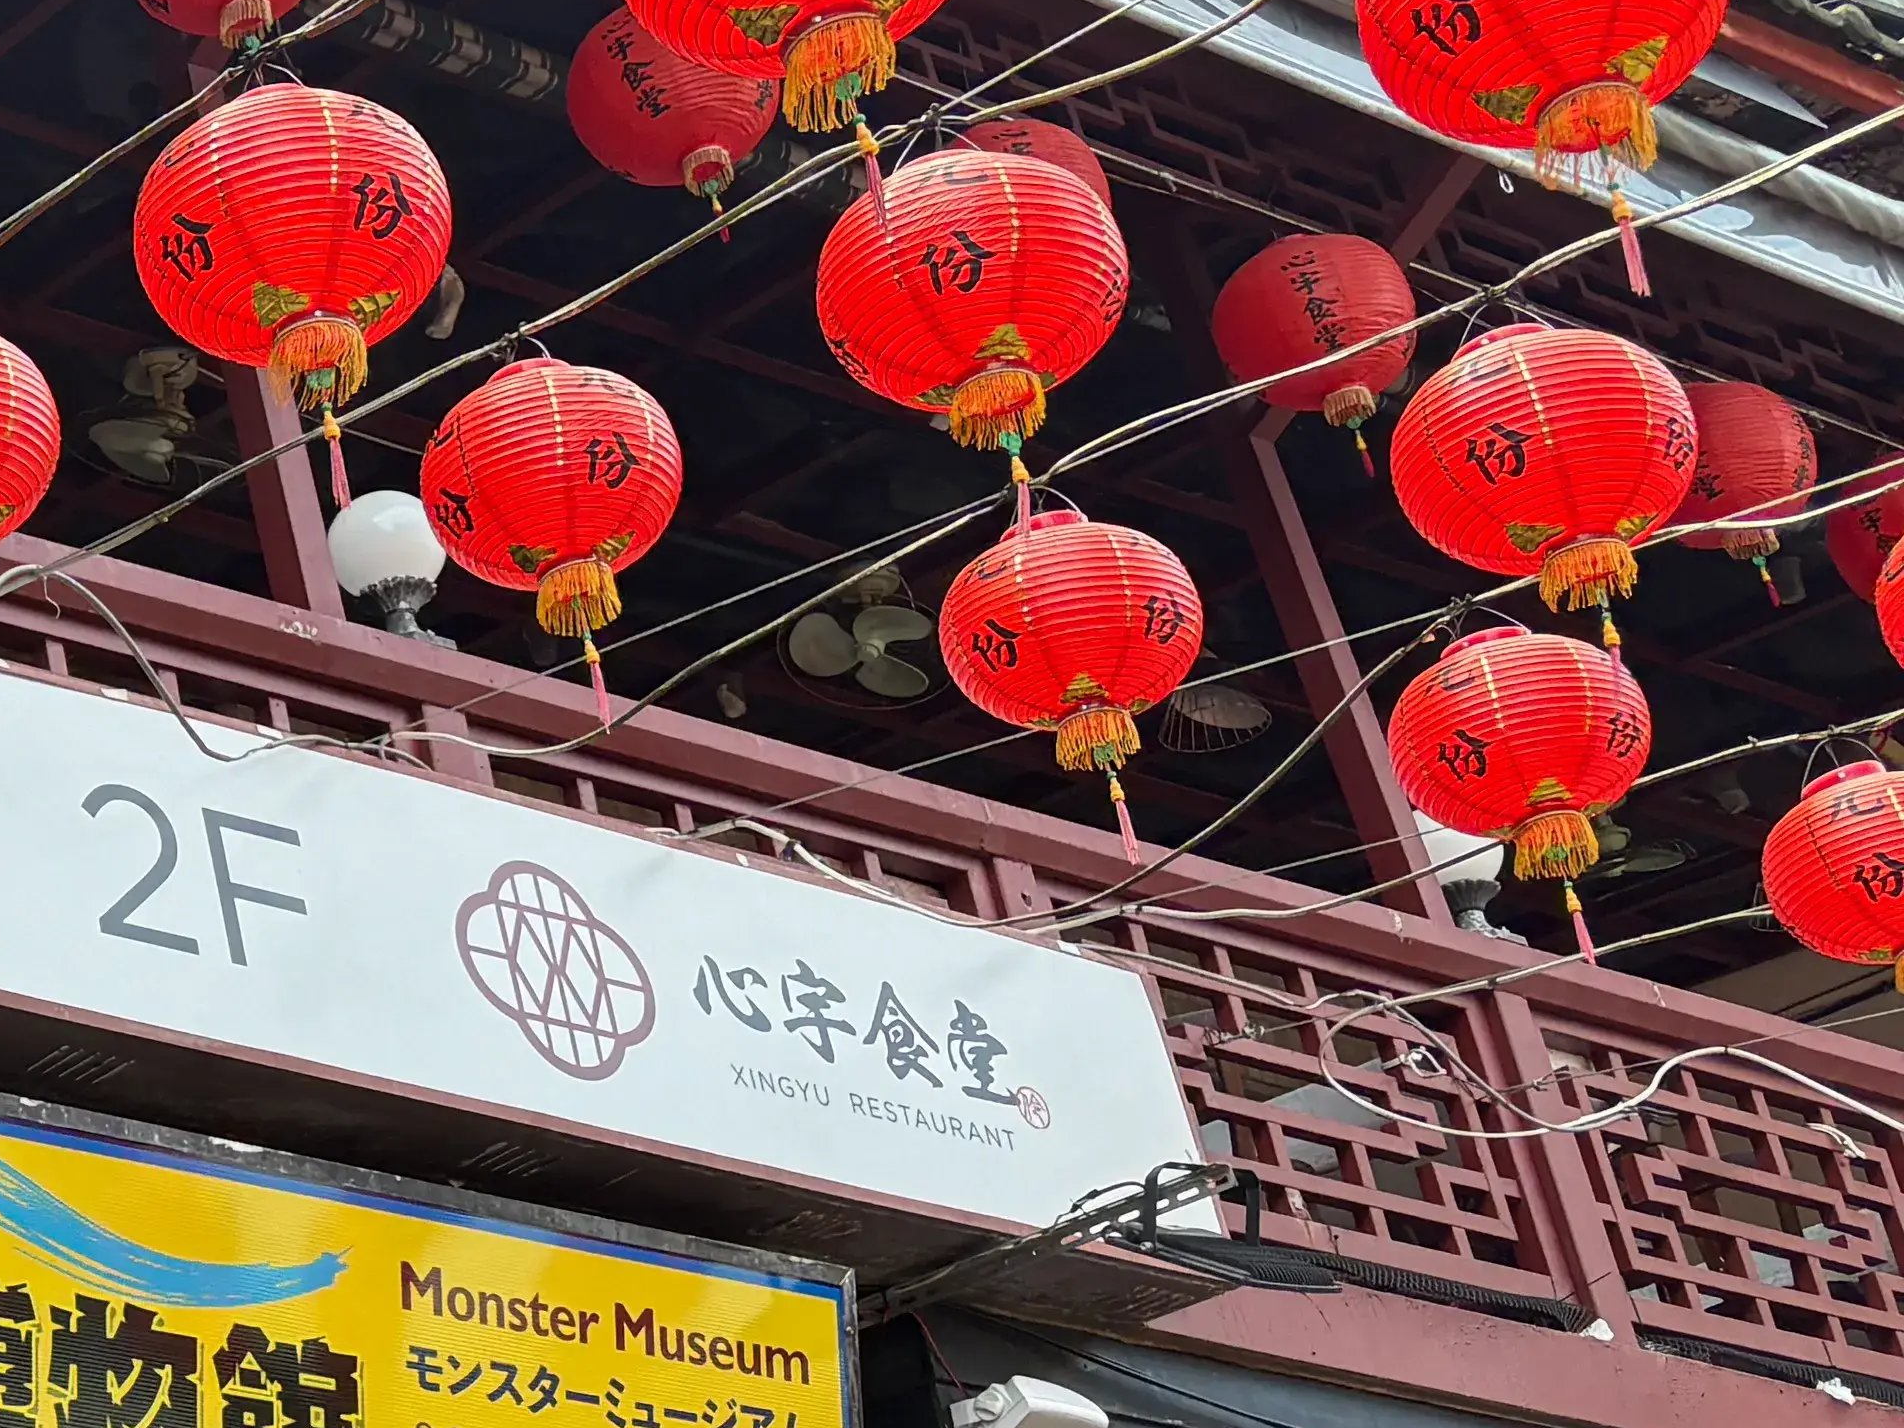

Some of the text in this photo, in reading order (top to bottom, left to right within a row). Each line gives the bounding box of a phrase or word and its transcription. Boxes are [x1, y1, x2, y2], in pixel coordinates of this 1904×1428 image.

[81, 783, 310, 969] 2F
[693, 954, 1021, 1107] 心宇食堂
[730, 1063, 1018, 1152] XINGYU RESTAURANT
[400, 1260, 811, 1386] Monster Museum
